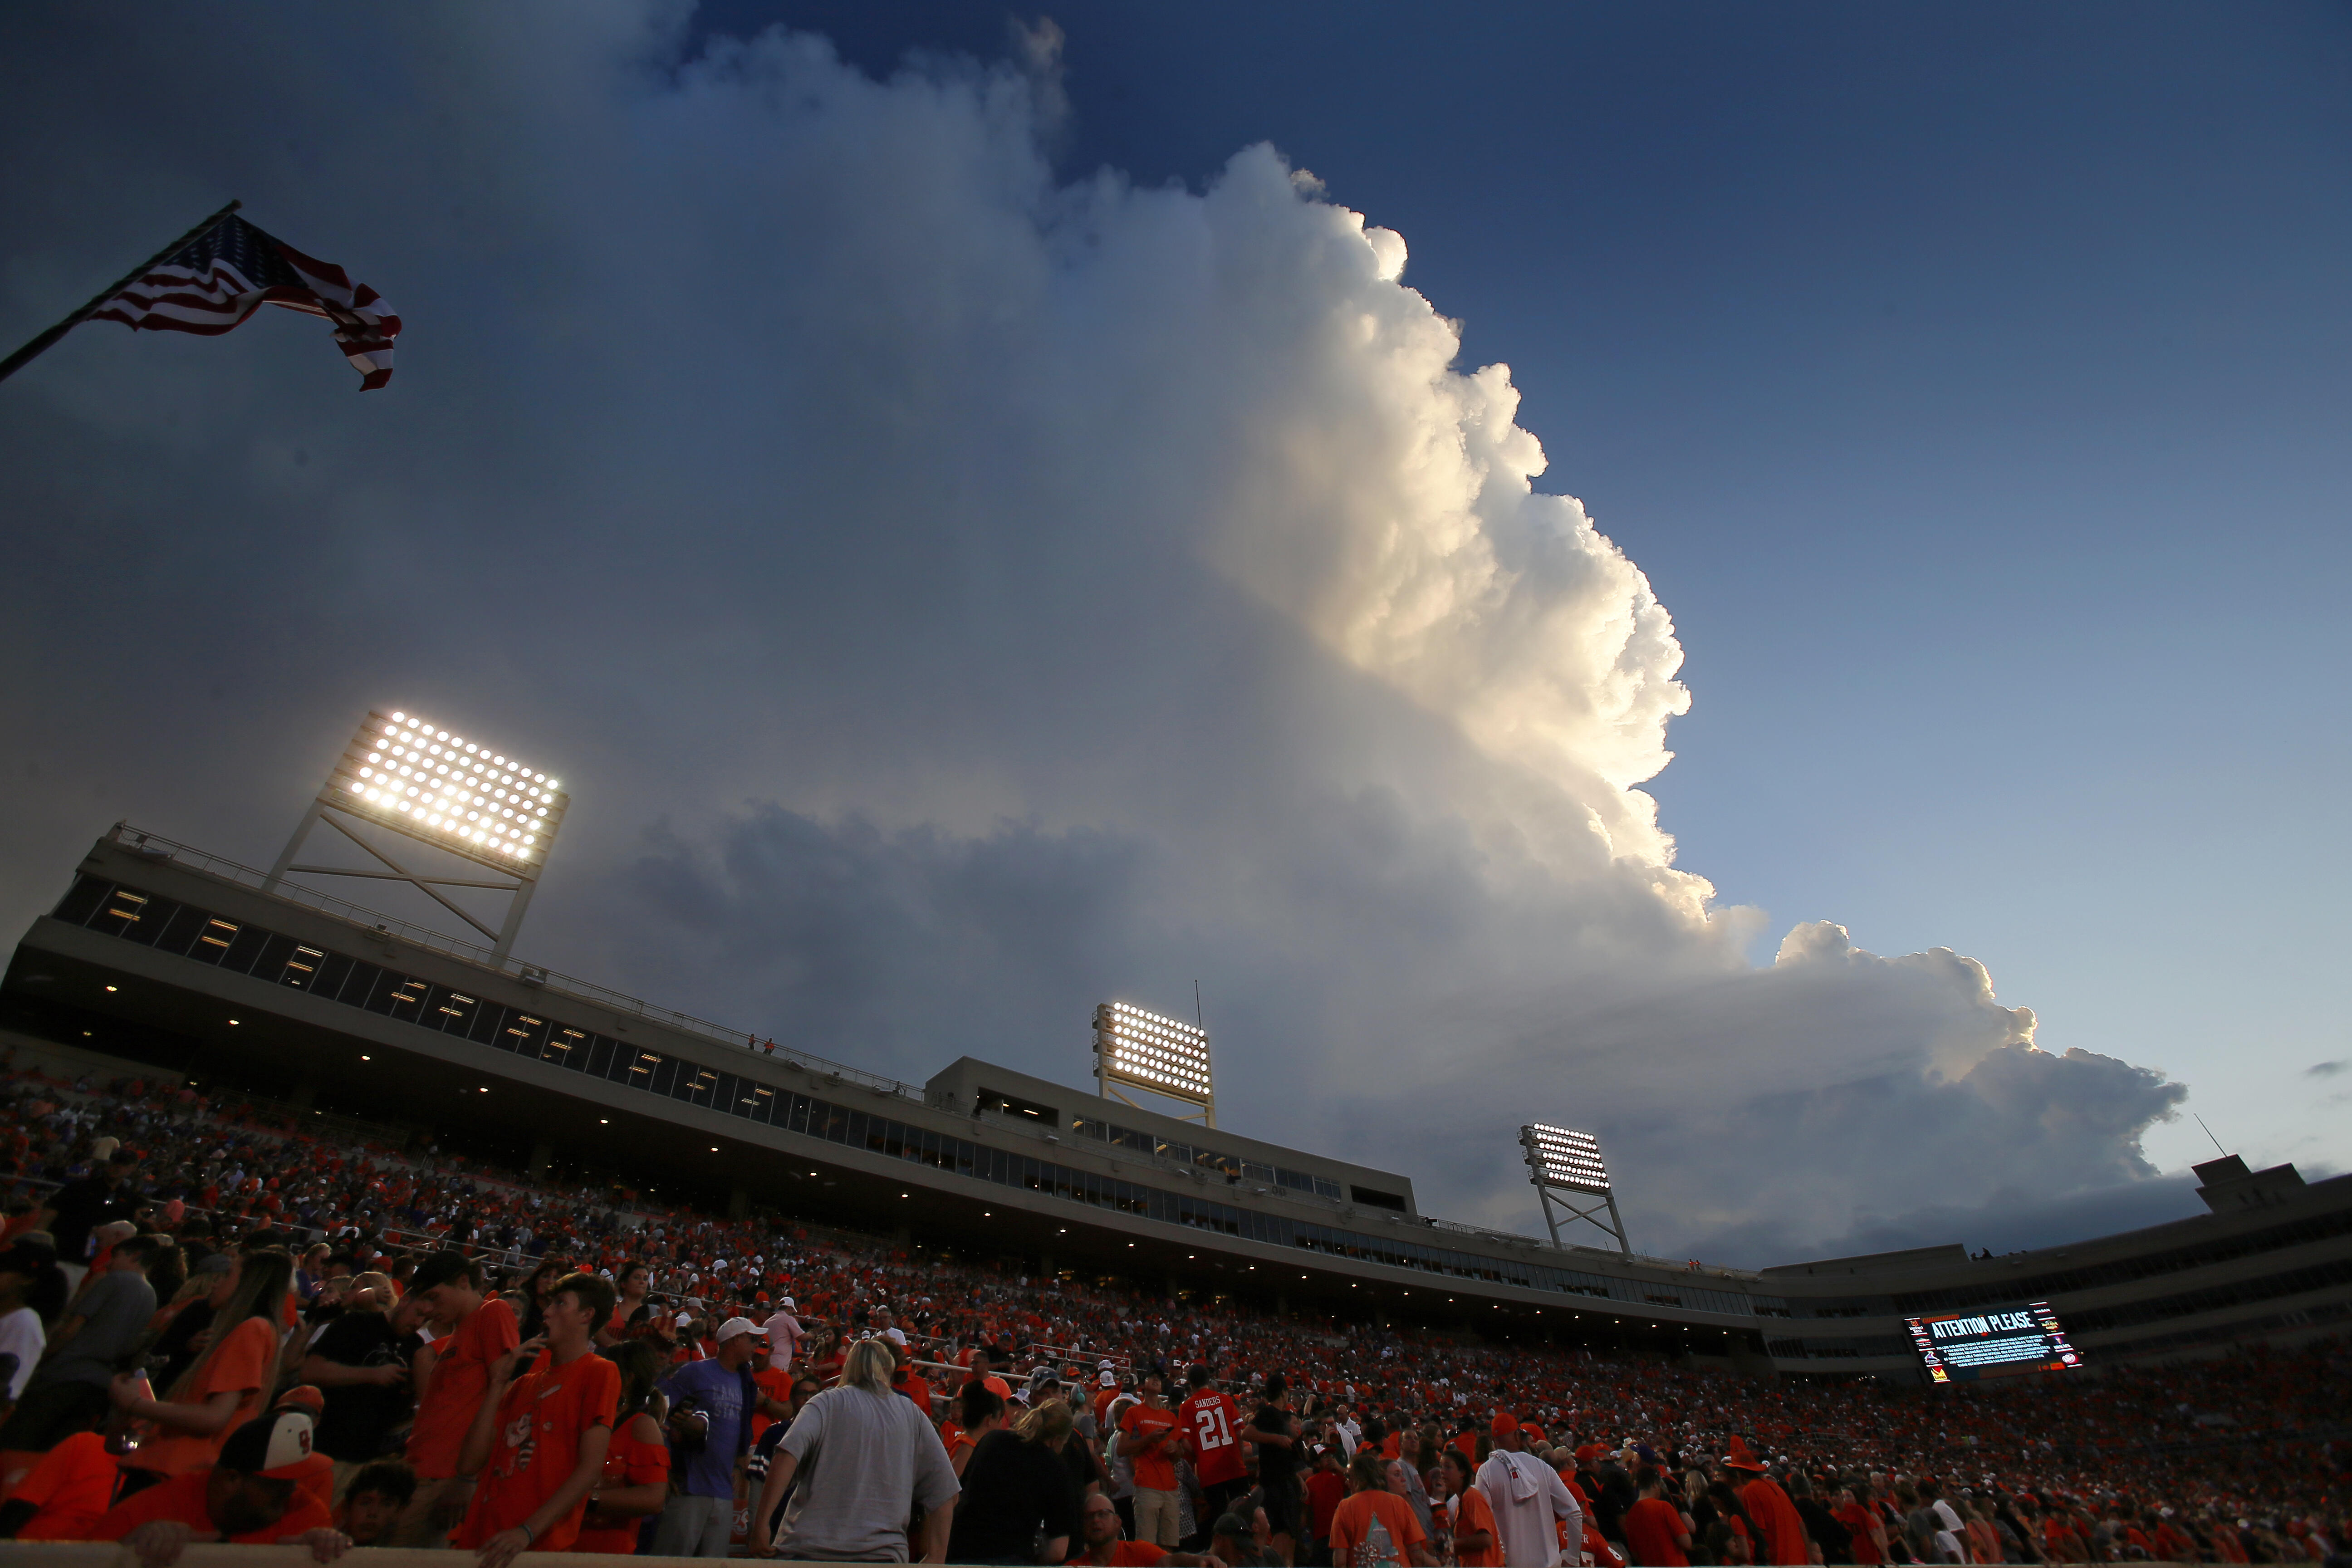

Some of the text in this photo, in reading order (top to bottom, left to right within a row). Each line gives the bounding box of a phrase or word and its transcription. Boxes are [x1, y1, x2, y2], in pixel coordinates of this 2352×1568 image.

[1931, 1311, 2035, 1338] ATTENTION PLEASE
[1195, 1396, 1220, 1408] SANDERS
[1196, 1406, 1233, 1450] 21
